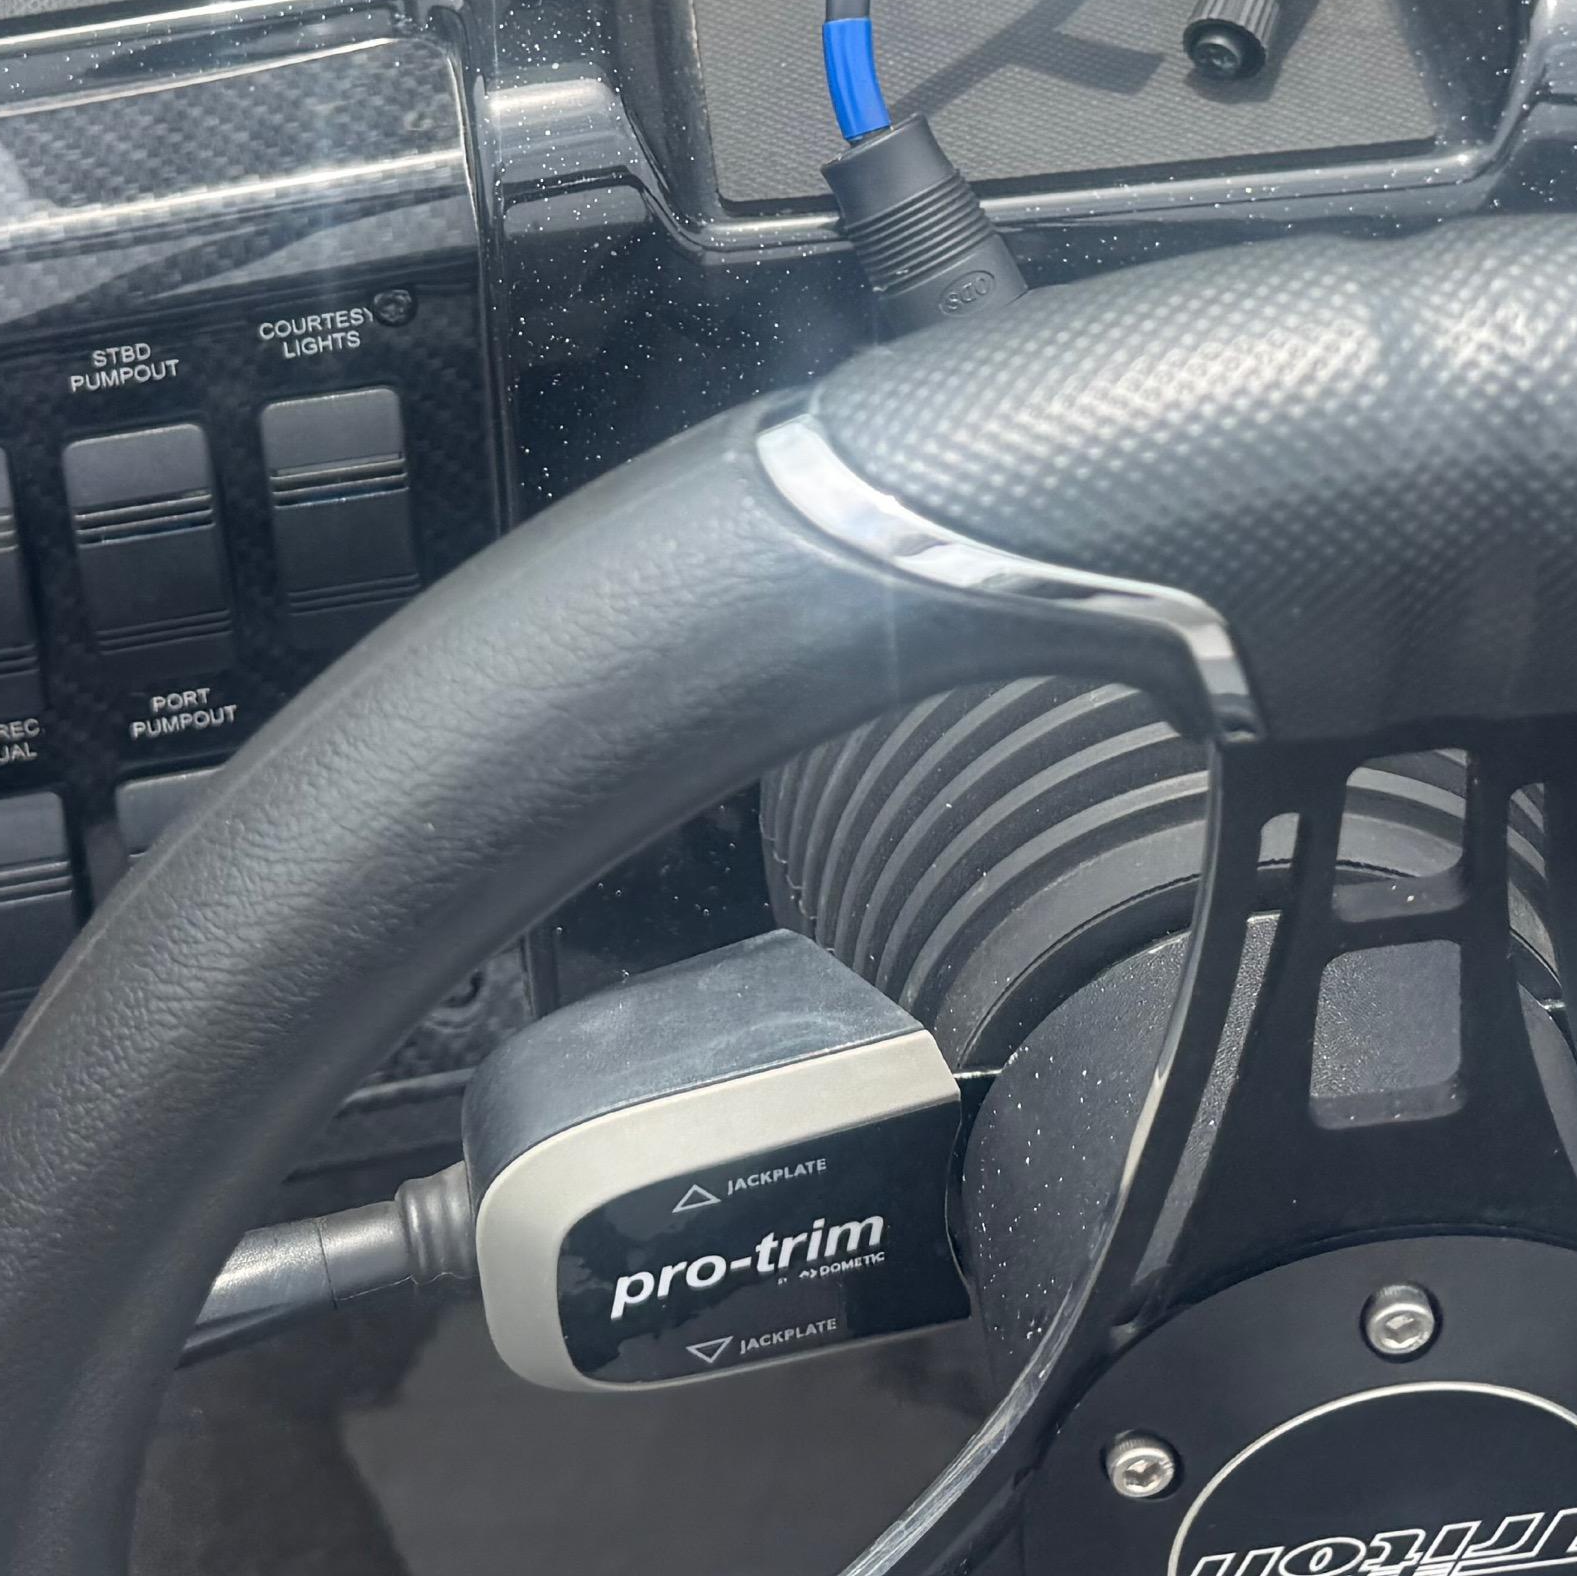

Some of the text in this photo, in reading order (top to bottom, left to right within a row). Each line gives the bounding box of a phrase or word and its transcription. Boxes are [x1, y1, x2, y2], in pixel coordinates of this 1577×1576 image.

[91, 341, 152, 369] STBD
[282, 329, 362, 360] LIGHTS
[69, 358, 180, 393] PUMPOUT
[152, 687, 211, 714] PORT
[130, 704, 237, 740] PUMPOUT
[727, 1157, 828, 1196] JACKPLATE
[609, 1214, 885, 1321] pro-trim
[819, 1251, 886, 1277] DOMETIC
[739, 1317, 838, 1355] JACKPLATE
